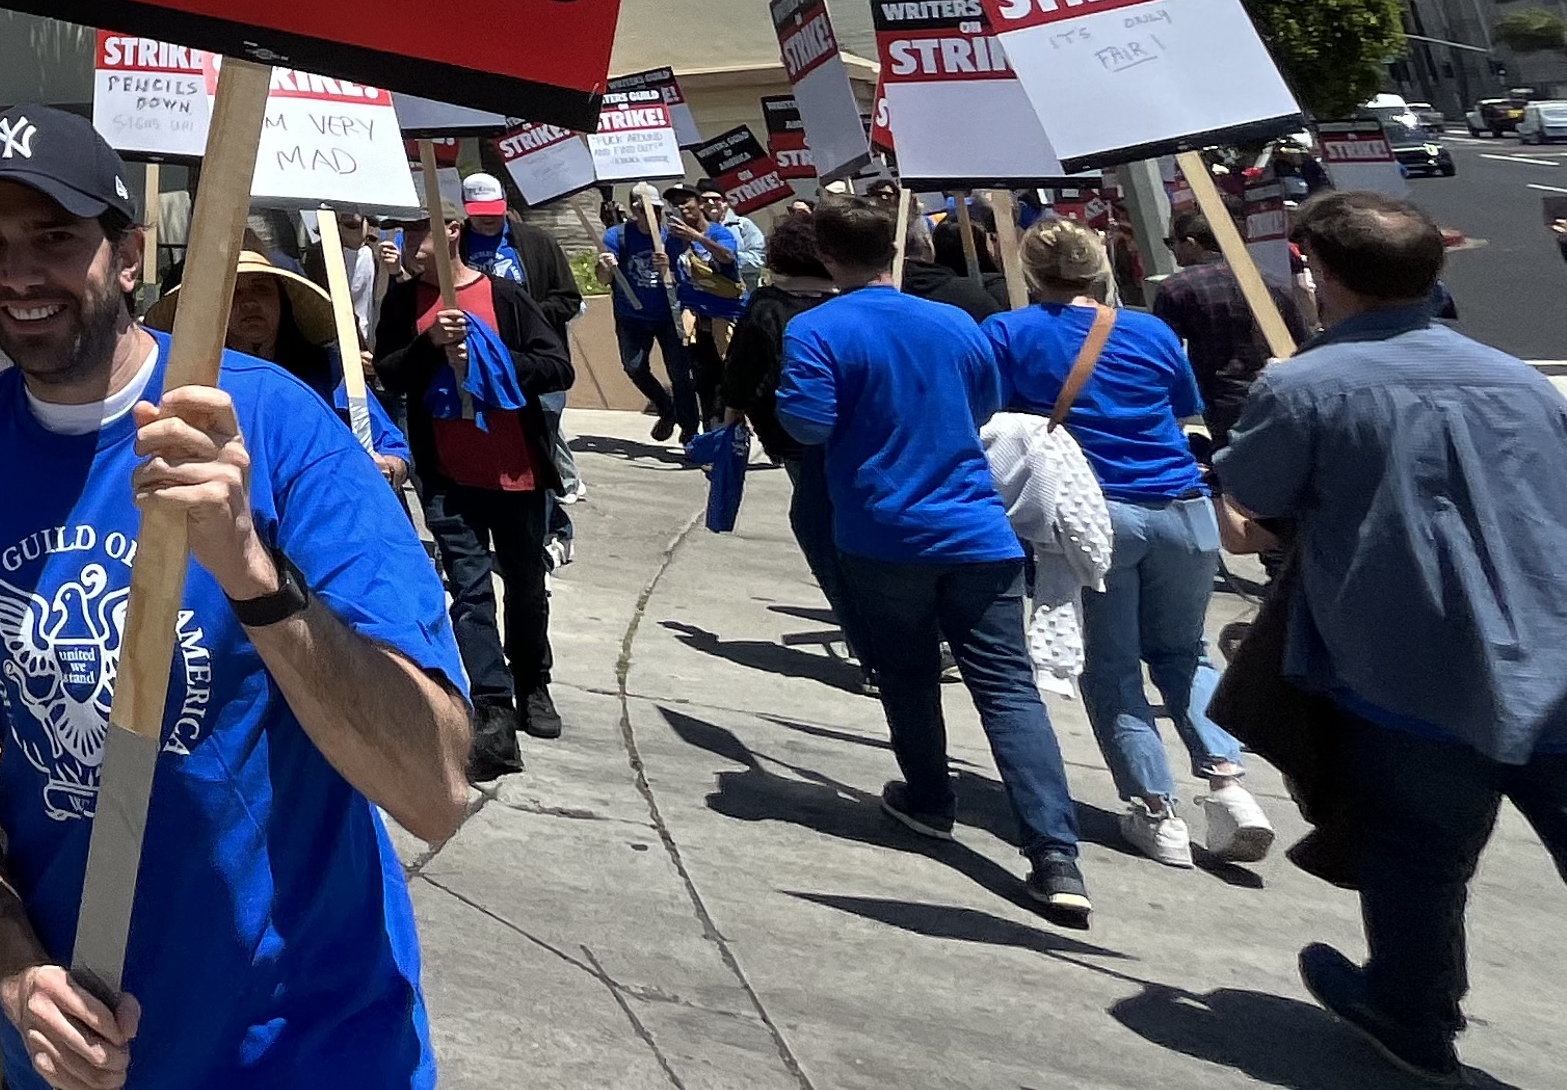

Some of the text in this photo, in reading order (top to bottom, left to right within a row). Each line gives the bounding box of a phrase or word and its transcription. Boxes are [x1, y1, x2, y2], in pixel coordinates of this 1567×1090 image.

[881, 0, 982, 22] WRITERS
[888, 36, 1014, 75] STRI
[108, 76, 198, 95] PENCILS
[136, 97, 191, 113] DOWN
[308, 113, 375, 141] VERY
[276, 146, 357, 175] MAD
[2, 524, 96, 571] GUILD
[58, 647, 96, 661] united
[61, 671, 95, 684] stand
[163, 609, 211, 756] AMERICA
